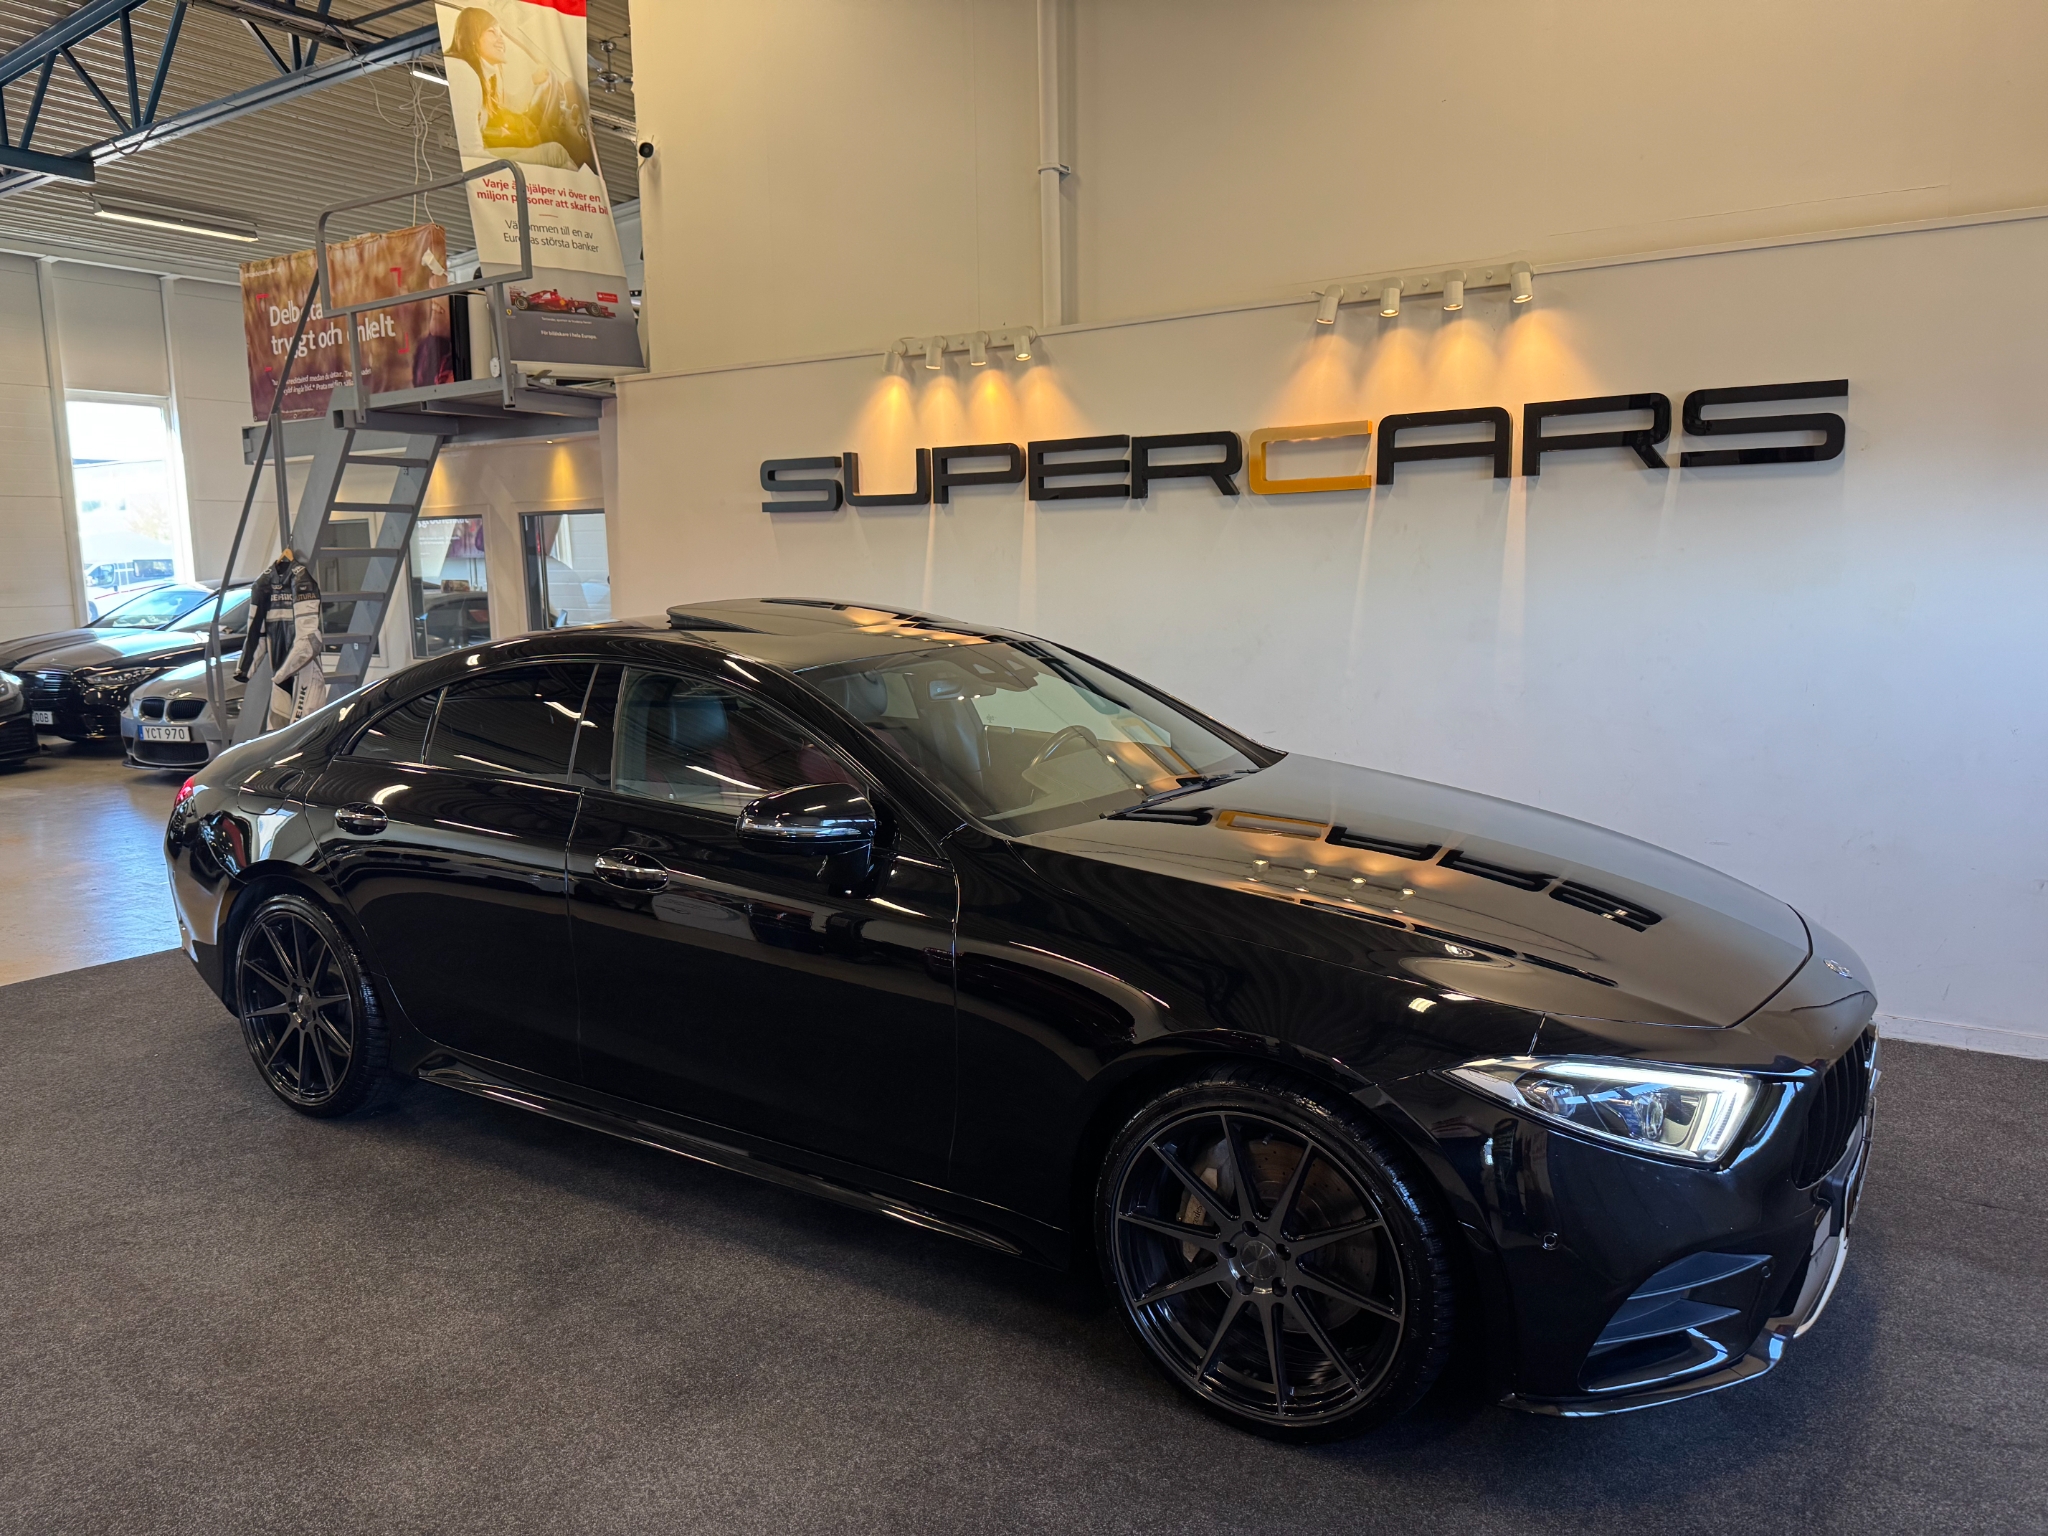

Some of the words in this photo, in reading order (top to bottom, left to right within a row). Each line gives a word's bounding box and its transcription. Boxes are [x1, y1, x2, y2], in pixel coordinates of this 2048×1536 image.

[476, 189, 509, 203] miljon
[511, 193, 554, 207] psoner
[555, 199, 570, 209] att
[570, 200, 597, 214] skaffa
[598, 204, 608, 215] bil
[482, 178, 509, 191] Varje
[557, 187, 567, 197] vi
[568, 189, 587, 201] över
[589, 194, 601, 203] en
[504, 219, 560, 235] Vämmen
[560, 225, 570, 236] till
[572, 229, 583, 238] en
[584, 231, 594, 240] av
[503, 232, 540, 246] Euras
[540, 235, 570, 249] största
[571, 239, 600, 253] banker
[271, 330, 317, 359] trygt
[318, 321, 343, 349] och
[347, 313, 397, 343] nkelt
[760, 378, 1849, 513] SUPERCARS
[145, 727, 162, 740] YCT
[164, 728, 185, 740] 970
